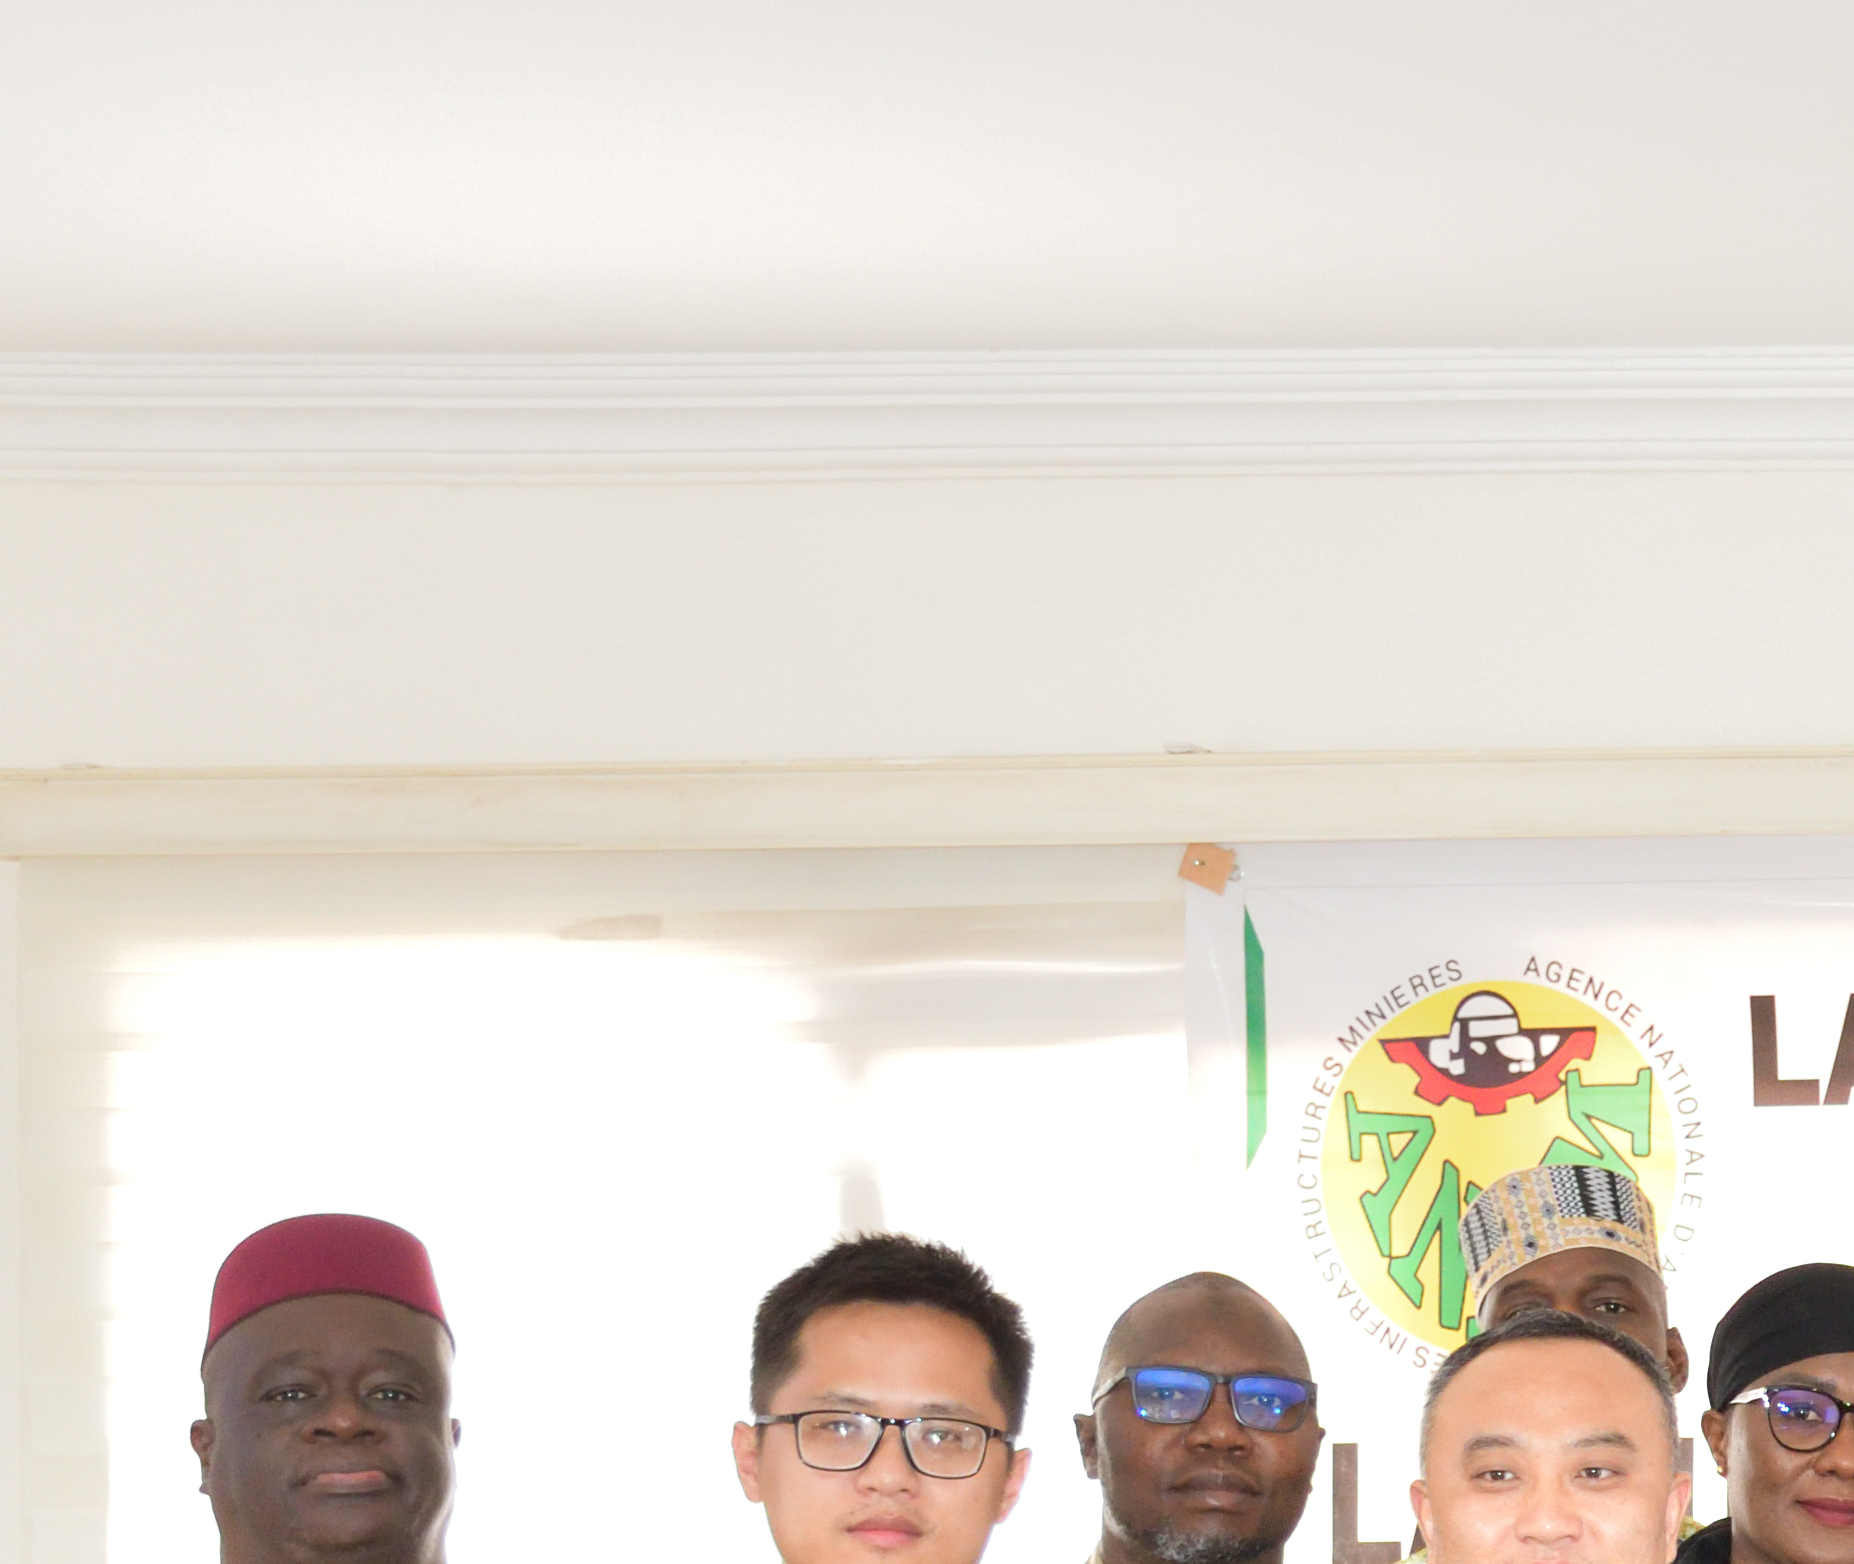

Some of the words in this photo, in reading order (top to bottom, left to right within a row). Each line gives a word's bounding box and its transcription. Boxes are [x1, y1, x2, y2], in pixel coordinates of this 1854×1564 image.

[1336, 959, 1463, 1053] MINIERES
[1523, 955, 1643, 1029] AGENCE
[1638, 1023, 1705, 1211] NATIONALE
[1297, 1056, 1408, 1356] INFRASTRUCTURES
